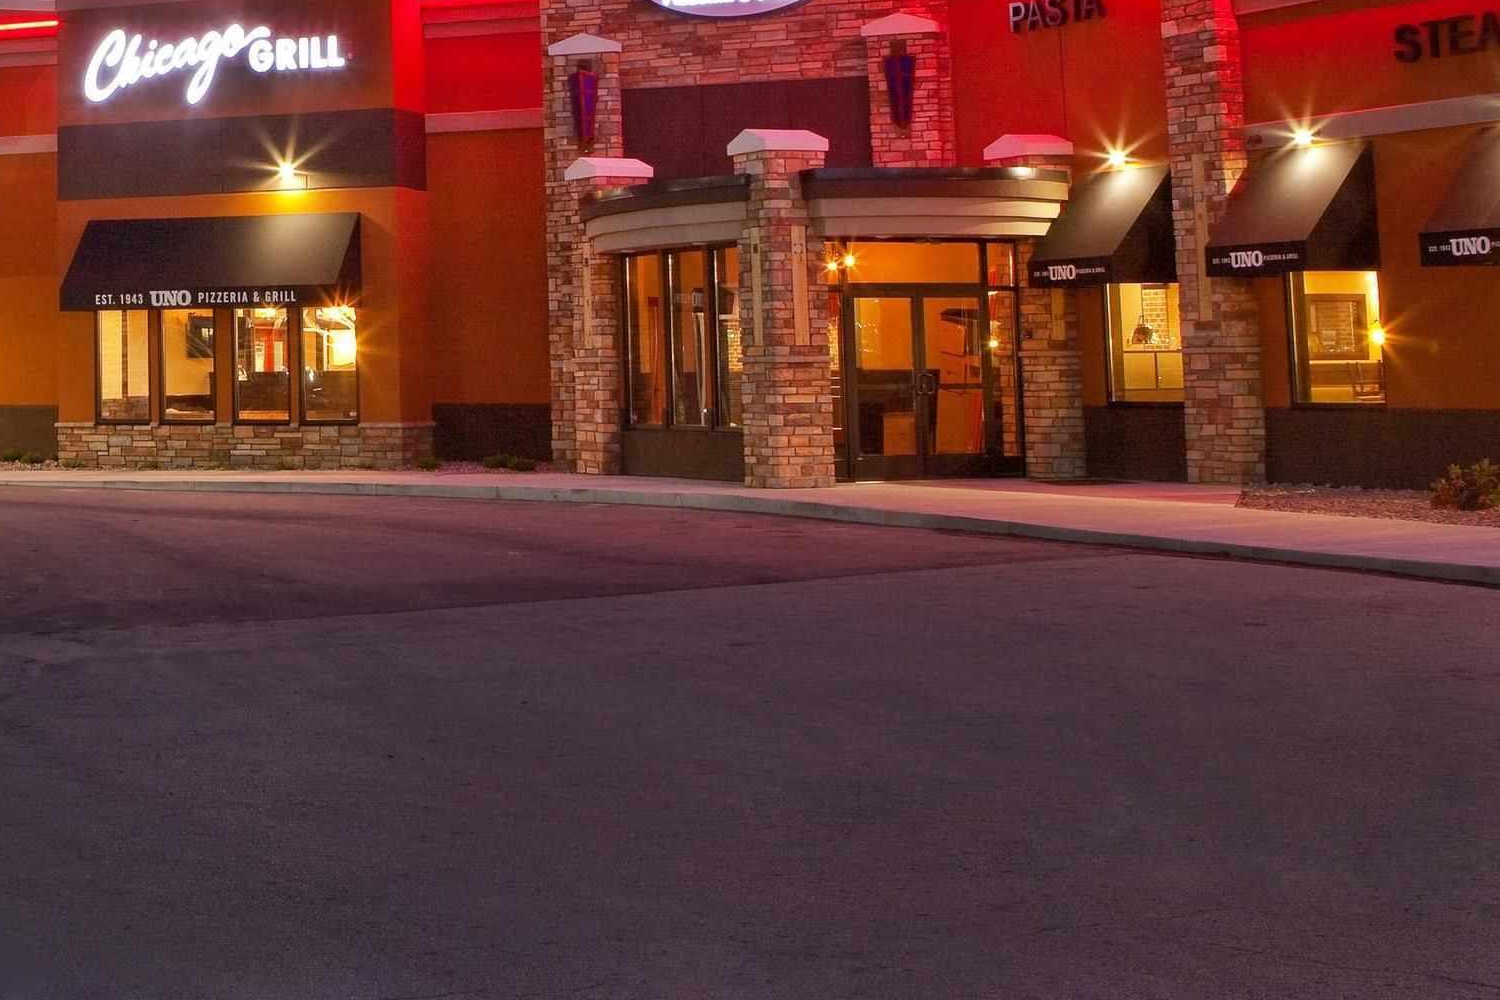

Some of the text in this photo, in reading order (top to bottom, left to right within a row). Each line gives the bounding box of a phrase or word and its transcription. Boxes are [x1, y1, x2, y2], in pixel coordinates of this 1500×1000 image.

[84, 24, 345, 105] Chicago GRILL
[1449, 236, 1491, 256] UNO
[1229, 250, 1263, 268] UNO
[1048, 264, 1076, 280] UNO
[95, 290, 297, 306] EST. 1943 UNO PIZZERIA & GRILL
